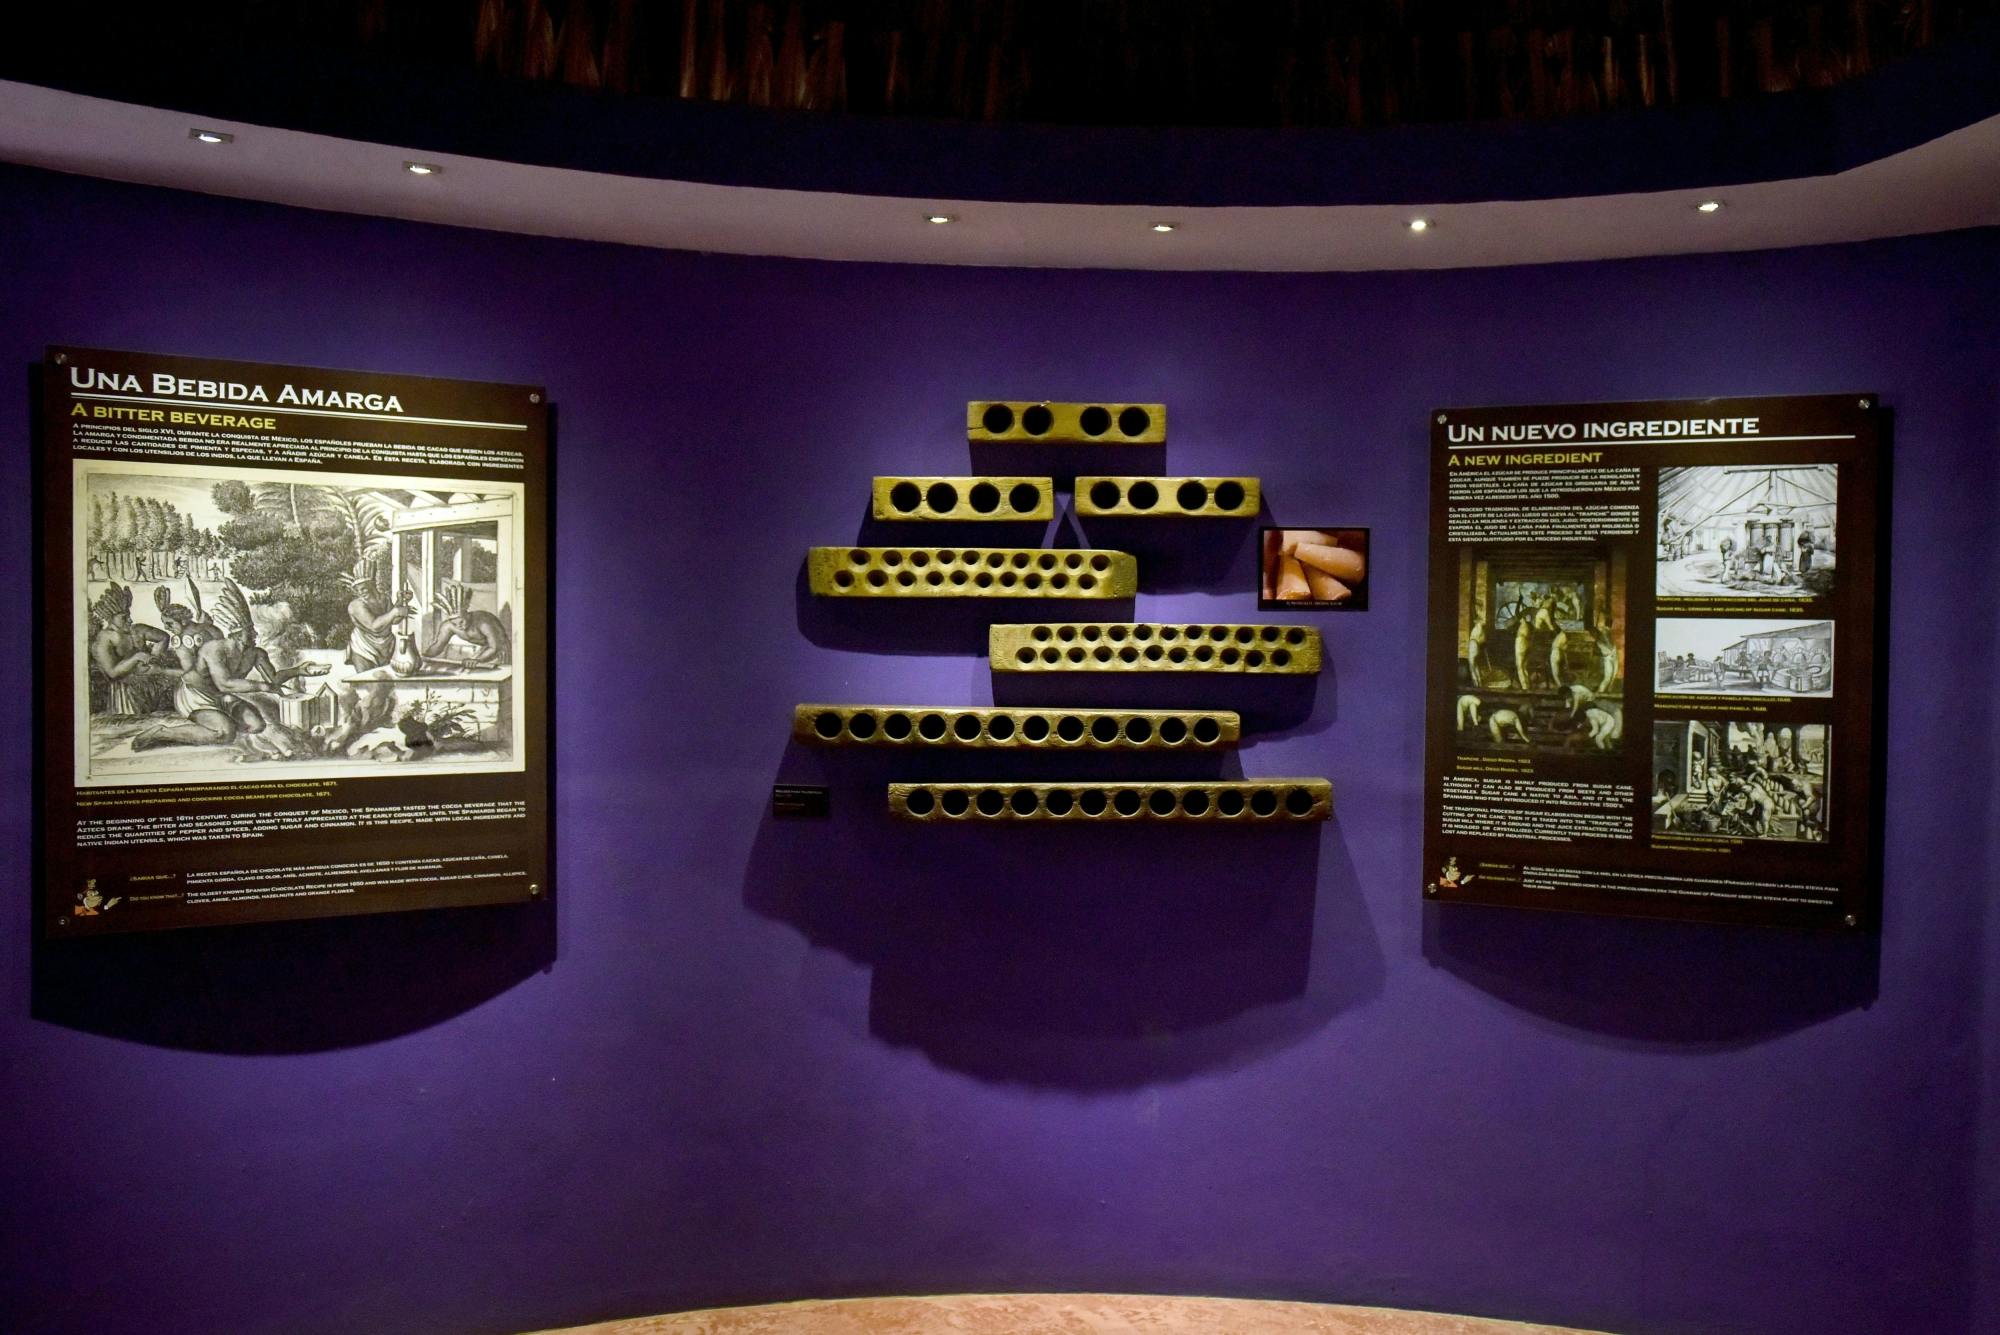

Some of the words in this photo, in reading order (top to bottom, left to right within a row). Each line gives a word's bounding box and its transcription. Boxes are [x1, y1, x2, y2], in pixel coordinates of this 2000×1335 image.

[70, 367, 143, 392] UNA
[153, 373, 269, 402] BEBIDA
[277, 384, 404, 412] AMARGA
[71, 402, 88, 417] A
[93, 406, 164, 422] BITTER
[170, 411, 277, 430] BEVERAGE
[1448, 424, 1486, 443] UN
[1492, 423, 1576, 441] NUEVO
[1583, 417, 1759, 439] INGREDIENTE
[1448, 454, 1460, 466] A
[1464, 454, 1501, 466] NEW
[1505, 451, 1603, 465] INGREDIENT
